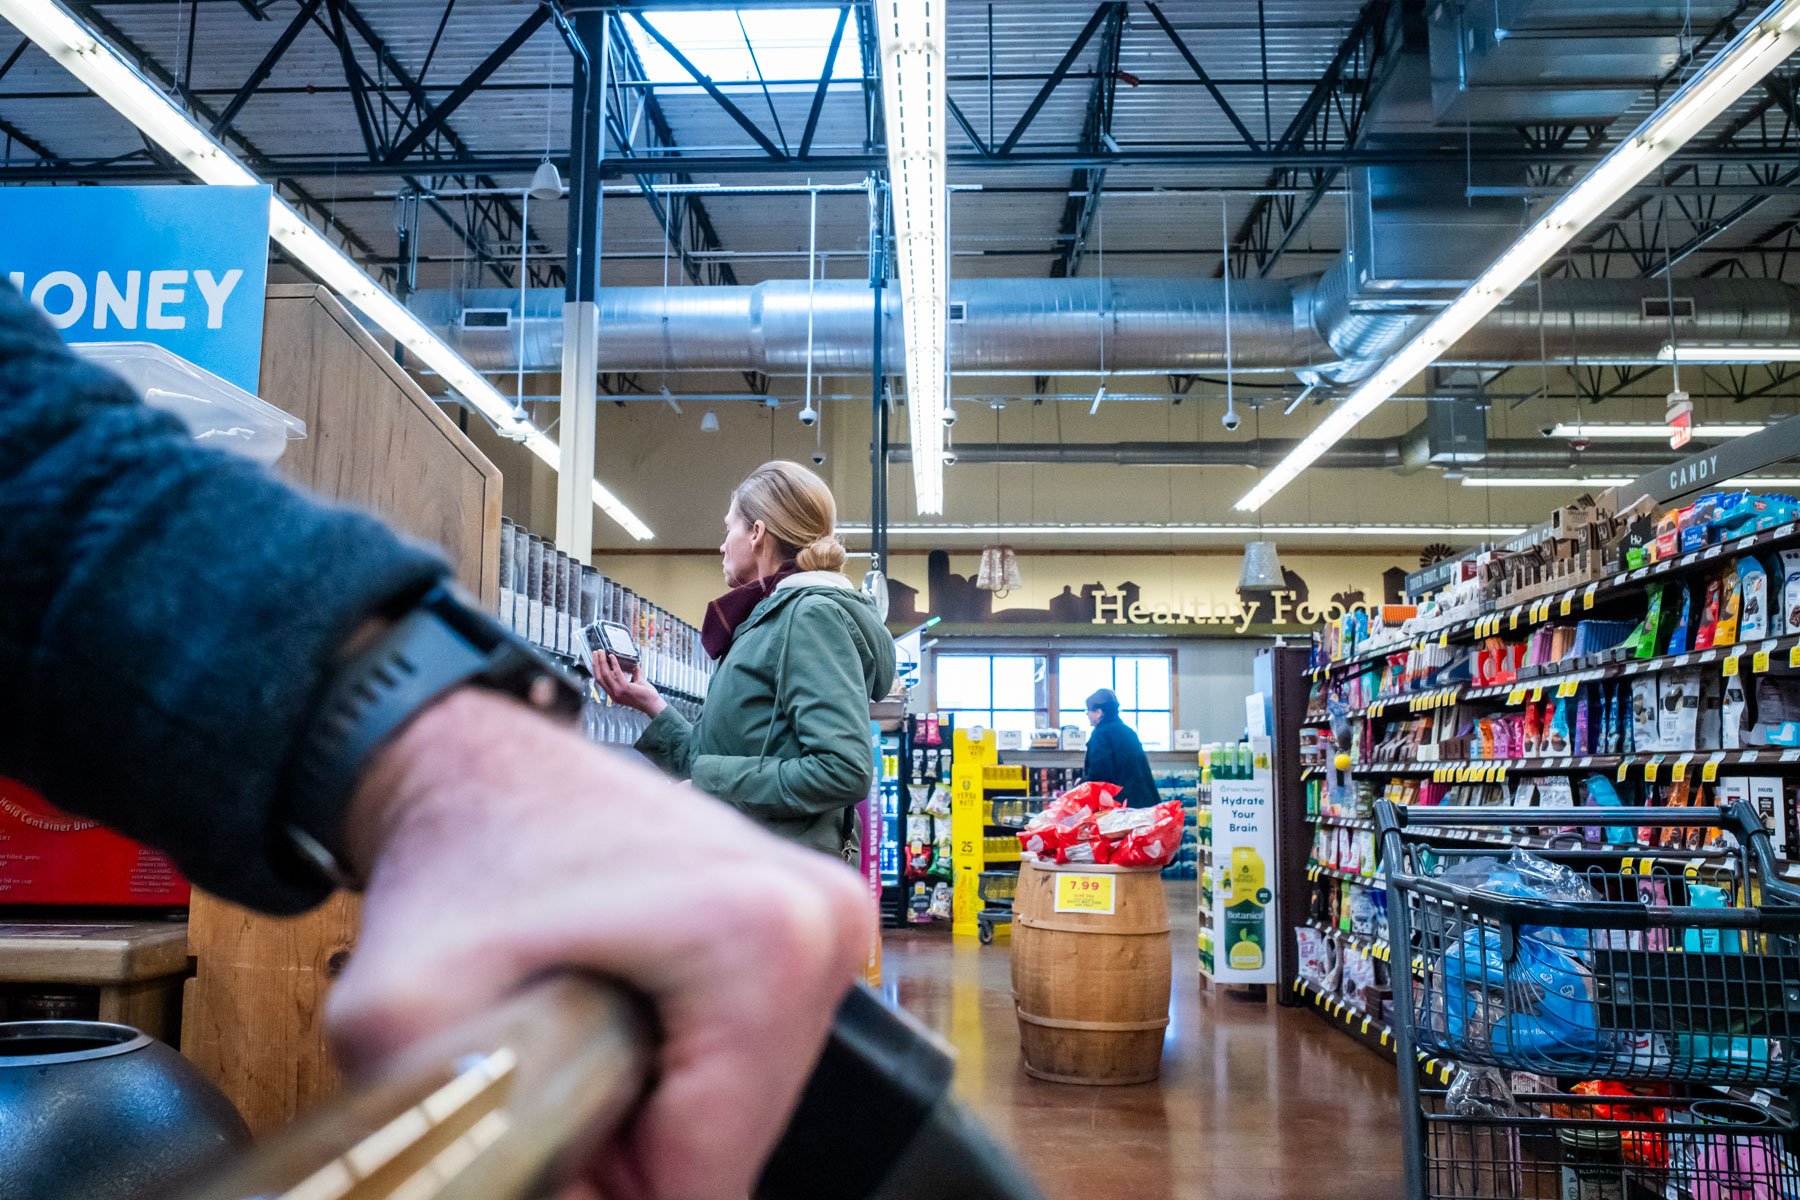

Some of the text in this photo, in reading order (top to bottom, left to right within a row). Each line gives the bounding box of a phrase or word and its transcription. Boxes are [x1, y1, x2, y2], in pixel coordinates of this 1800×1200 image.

[9, 269, 244, 330] ONEY
[1669, 455, 1718, 490] CANDY
[1092, 590, 1260, 633] Healthy
[1270, 587, 1373, 625] Food
[1221, 796, 1265, 807] Hydrate
[1231, 810, 1256, 819] Your
[21, 812, 71, 832] Container
[1229, 823, 1258, 832] Brain
[961, 841, 973, 853] 25
[1070, 880, 1100, 891] 7.99
